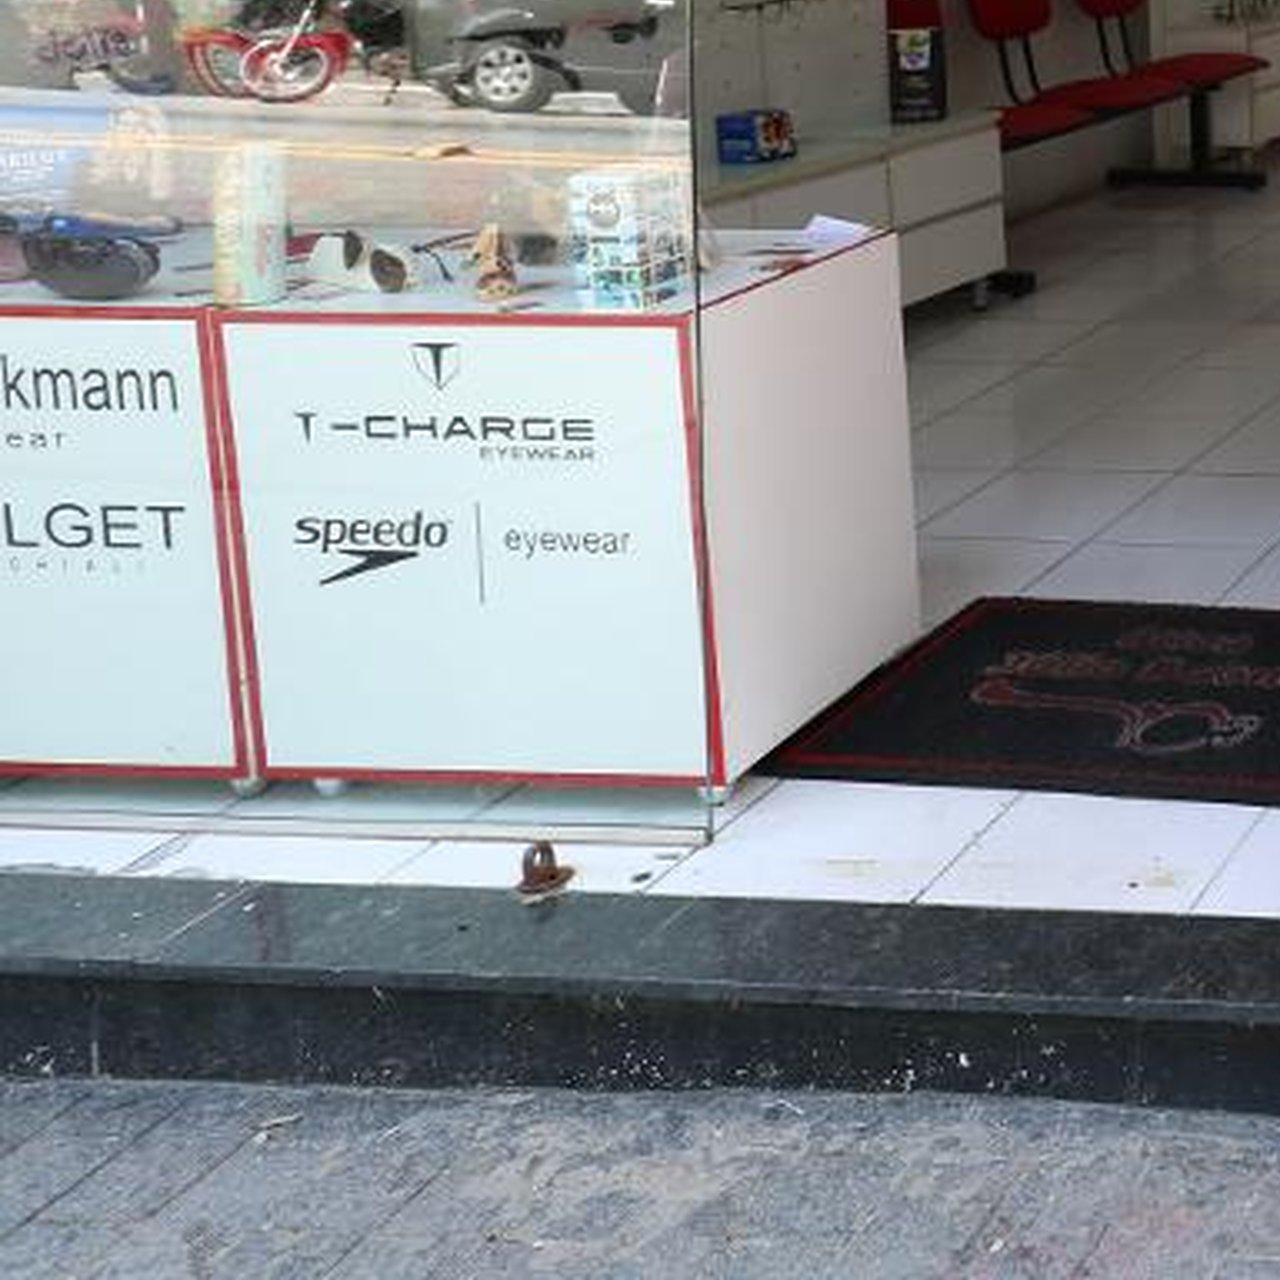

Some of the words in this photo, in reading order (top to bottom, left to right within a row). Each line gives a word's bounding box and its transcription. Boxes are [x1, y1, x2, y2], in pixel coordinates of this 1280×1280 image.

[0, 353, 178, 412] kmann
[294, 412, 595, 443] T-CHARGE
[479, 445, 595, 461] EYEWEAR
[3, 502, 186, 550] LGET
[293, 509, 452, 553] speedo
[503, 527, 632, 559] eyewear
